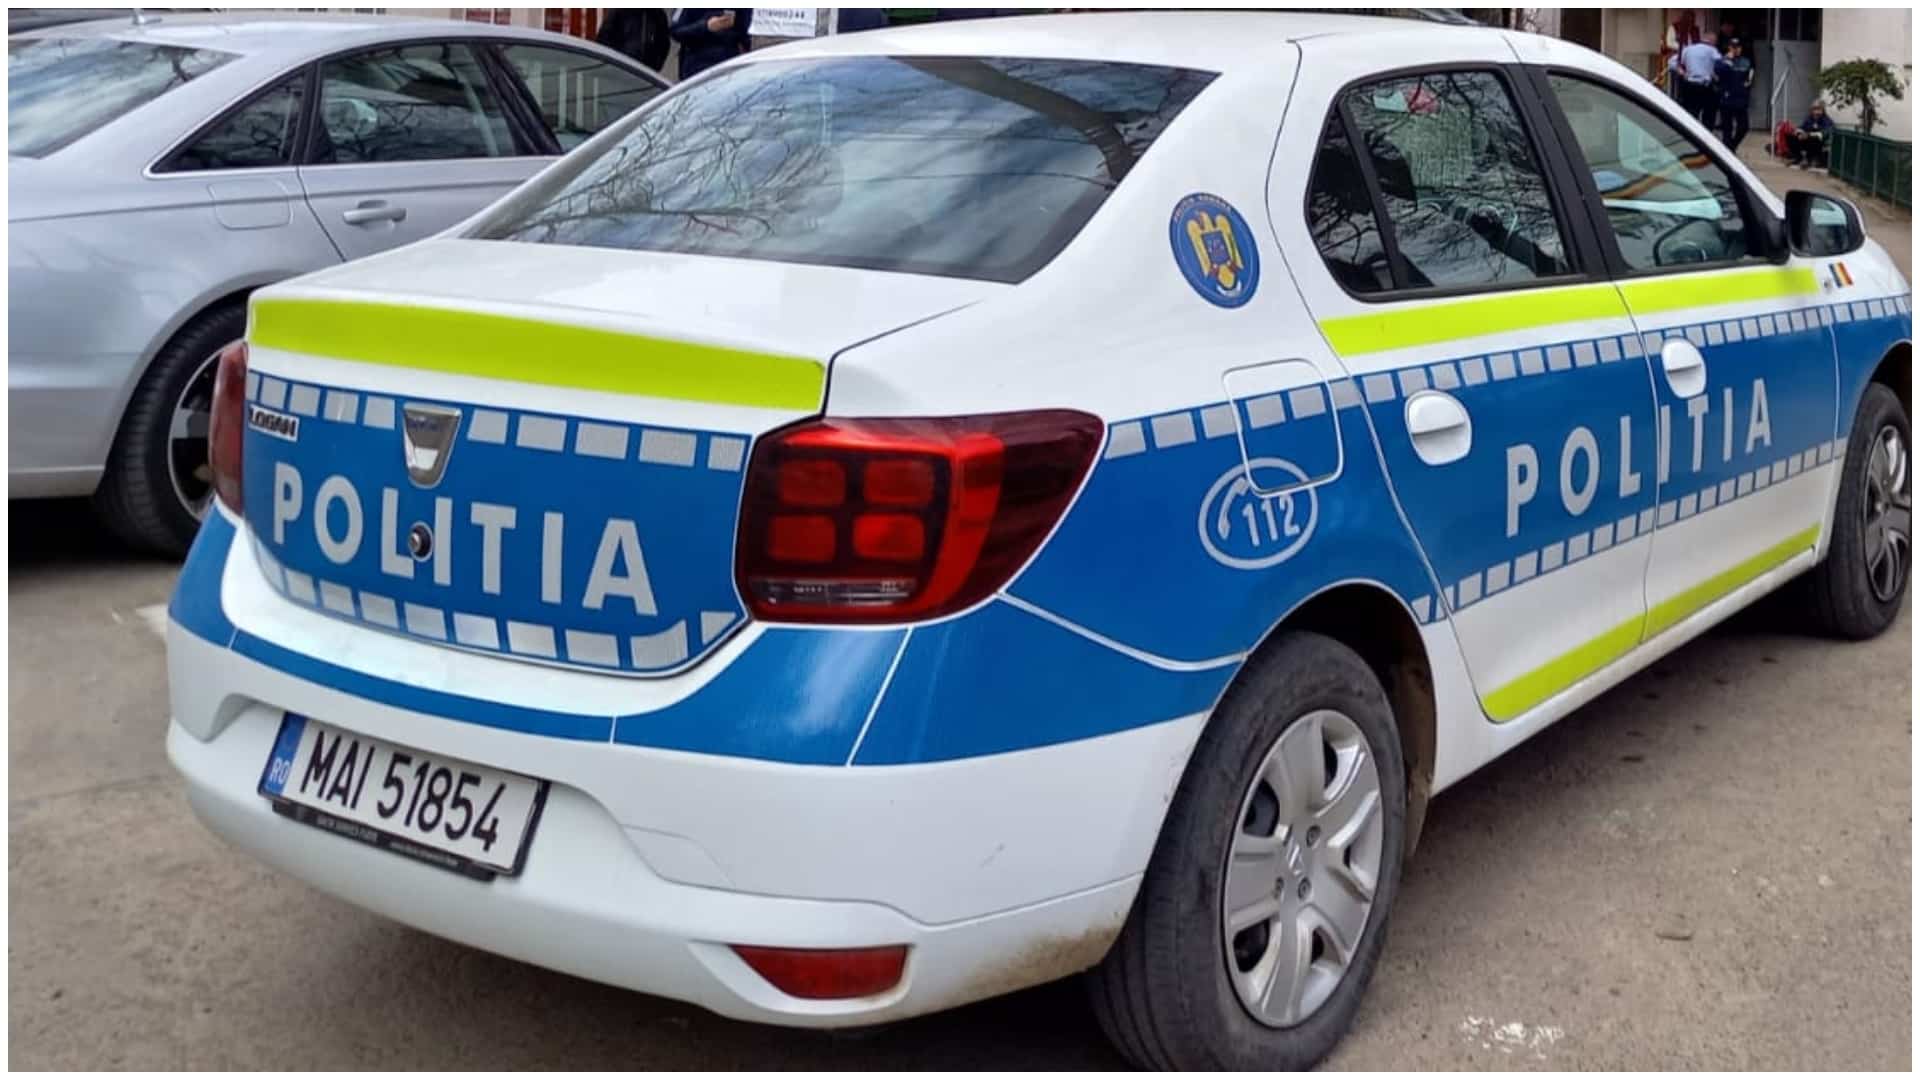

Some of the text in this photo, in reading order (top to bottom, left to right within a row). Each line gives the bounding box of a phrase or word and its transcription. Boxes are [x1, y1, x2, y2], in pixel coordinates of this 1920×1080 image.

[248, 406, 297, 439] LOGAN
[1506, 378, 1772, 538] POLITIA
[274, 461, 659, 617] POLITIA
[1242, 493, 1300, 547] 112
[269, 758, 291, 785] RO
[300, 730, 506, 853] MAI 51854
